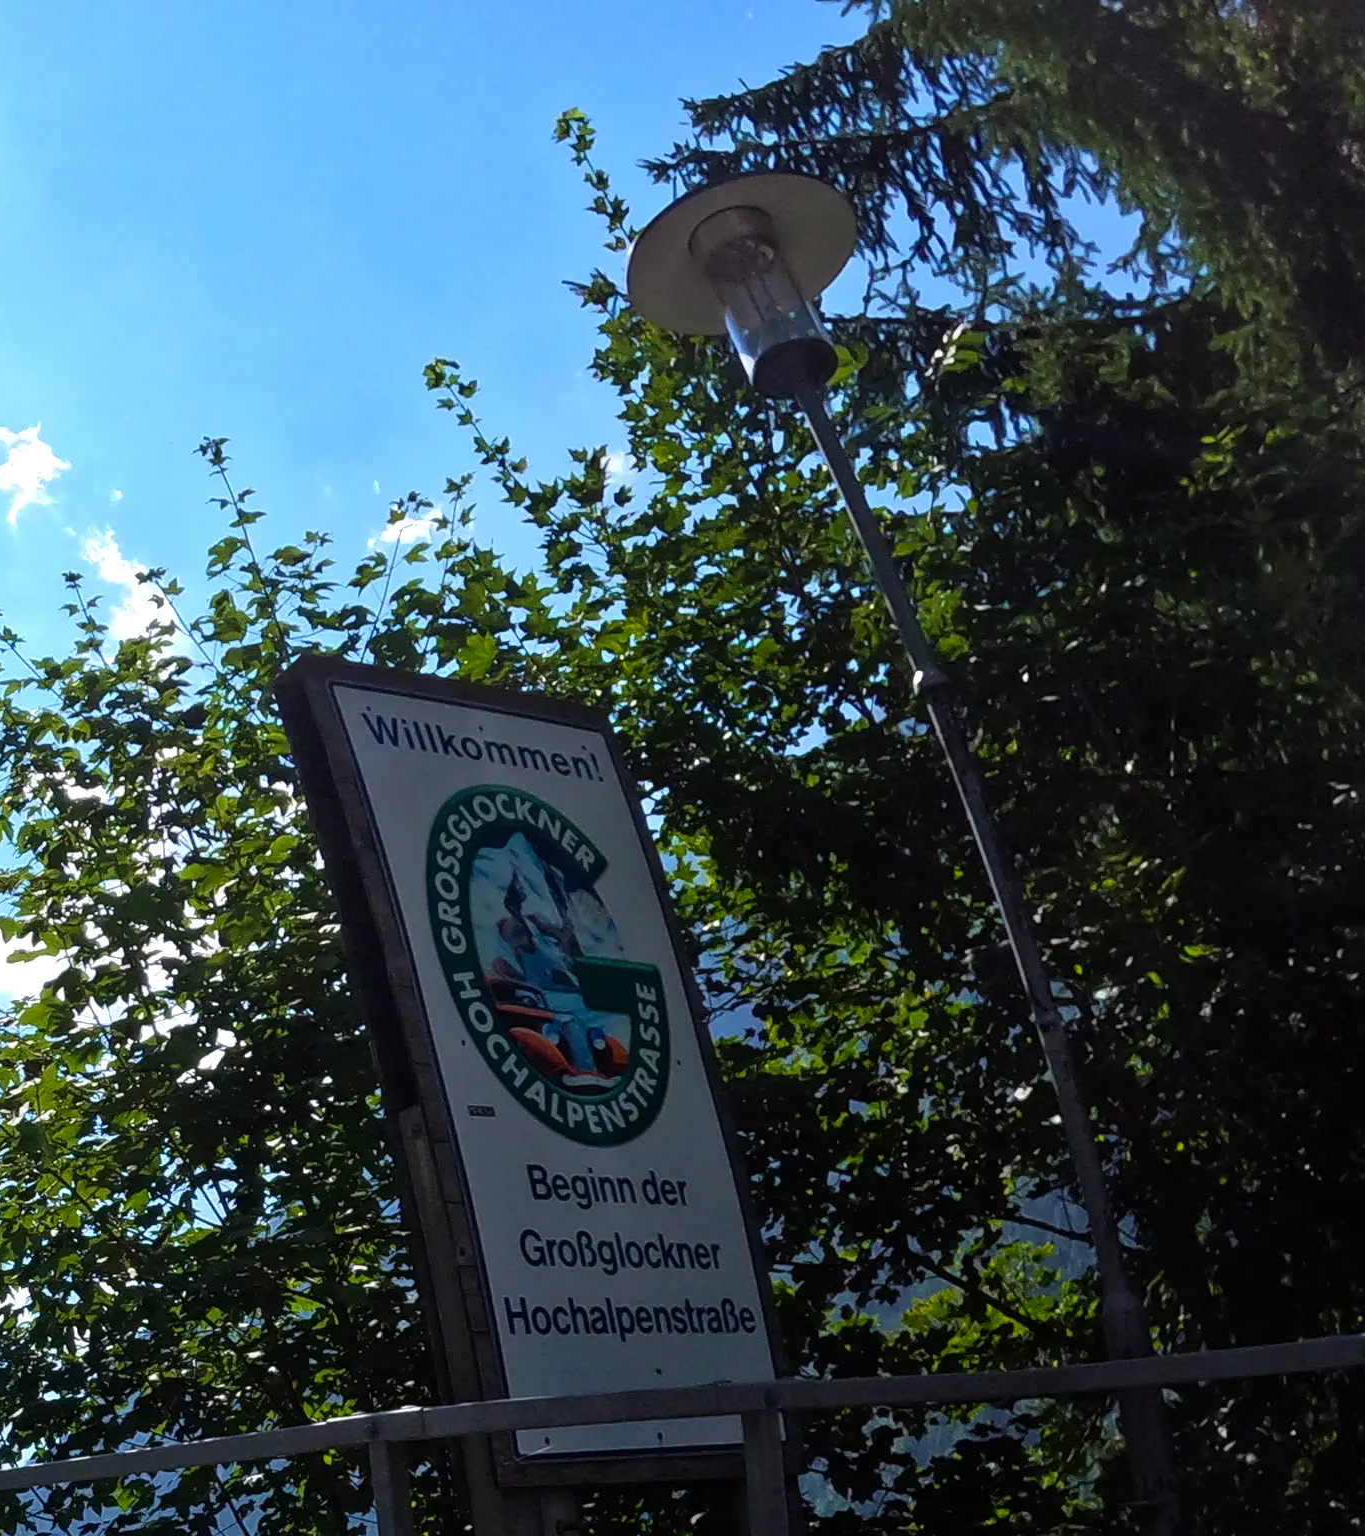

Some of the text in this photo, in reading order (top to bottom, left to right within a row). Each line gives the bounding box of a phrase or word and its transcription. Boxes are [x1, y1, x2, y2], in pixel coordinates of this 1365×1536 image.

[361, 712, 605, 783] Willkommen!
[434, 792, 662, 1134] GROSSGLOCKNER HOCHALPENSTRASSE
[526, 1163, 688, 1210] Beginn der
[519, 1228, 721, 1277] Großglockner
[502, 1296, 758, 1344] Hochalpenstraße
